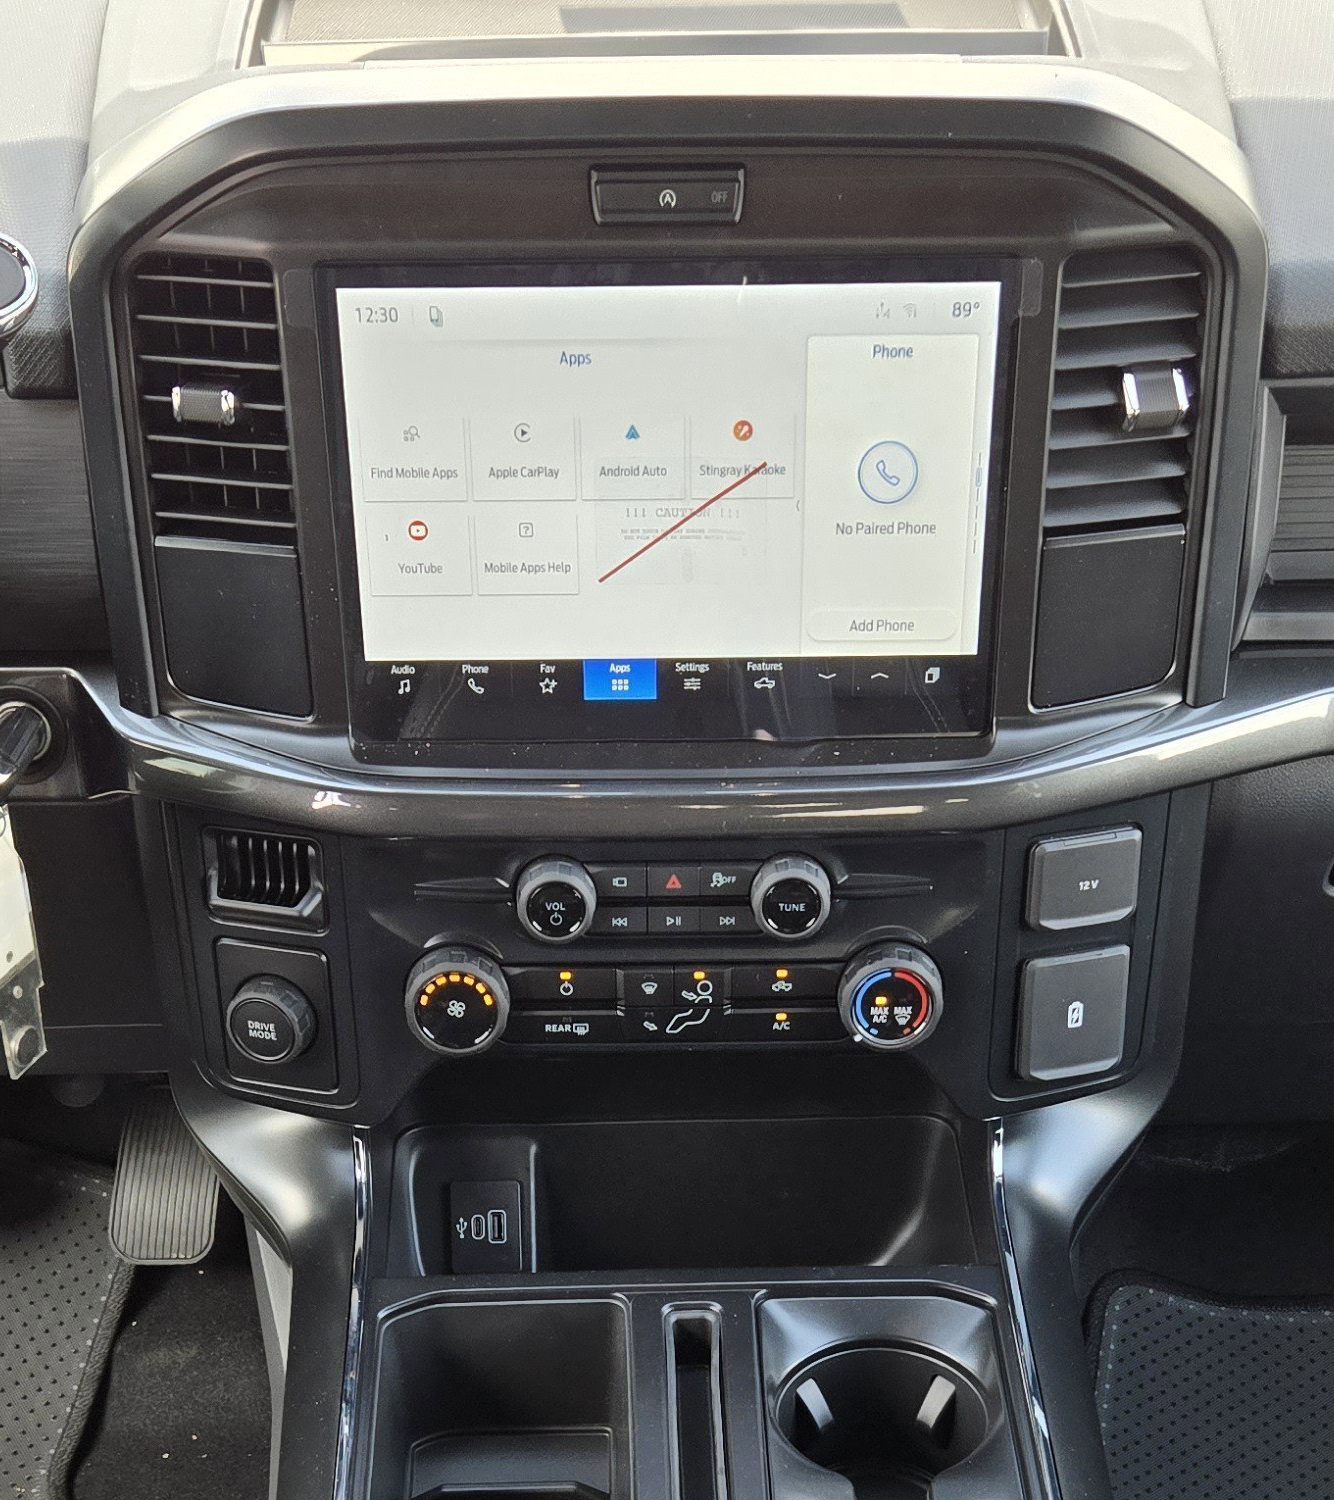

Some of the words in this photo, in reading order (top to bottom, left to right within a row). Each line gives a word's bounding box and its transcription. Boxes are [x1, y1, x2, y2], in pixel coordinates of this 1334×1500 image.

[710, 190, 729, 203] OFF
[354, 306, 399, 324] 12:30
[872, 343, 914, 359] Phone
[559, 350, 592, 368] Apps
[370, 466, 394, 479] Find
[395, 466, 430, 479] Mobile
[432, 467, 459, 480] Apps
[488, 466, 519, 480] Apple
[520, 465, 560, 480] CarPlay
[599, 464, 640, 478] Android
[641, 465, 668, 477] Auto
[699, 463, 742, 478] Stingray
[835, 522, 853, 536] No
[855, 521, 895, 535] Paired
[896, 521, 937, 535] Phone
[397, 562, 443, 575] YouTube
[484, 561, 518, 574] Mobile
[519, 561, 546, 574] Apps
[547, 561, 572, 574] Help
[849, 619, 874, 632] Add
[876, 619, 915, 632] Phone
[390, 664, 416, 675] Audio
[461, 663, 490, 674] Phone
[539, 663, 556, 675] Fav
[609, 662, 631, 674] Apps
[675, 661, 710, 673] Settings
[746, 660, 783, 672] Features
[545, 901, 566, 911] VOL
[778, 902, 806, 912] TUNE
[870, 1006, 890, 1015] MAX
[893, 1005, 913, 1015] MAX
[872, 1014, 888, 1024] A/C
[247, 1020, 276, 1032] DRIVE
[544, 1023, 572, 1033] REAR
[772, 1021, 791, 1031] A/C
[248, 1029, 278, 1041] MODE
